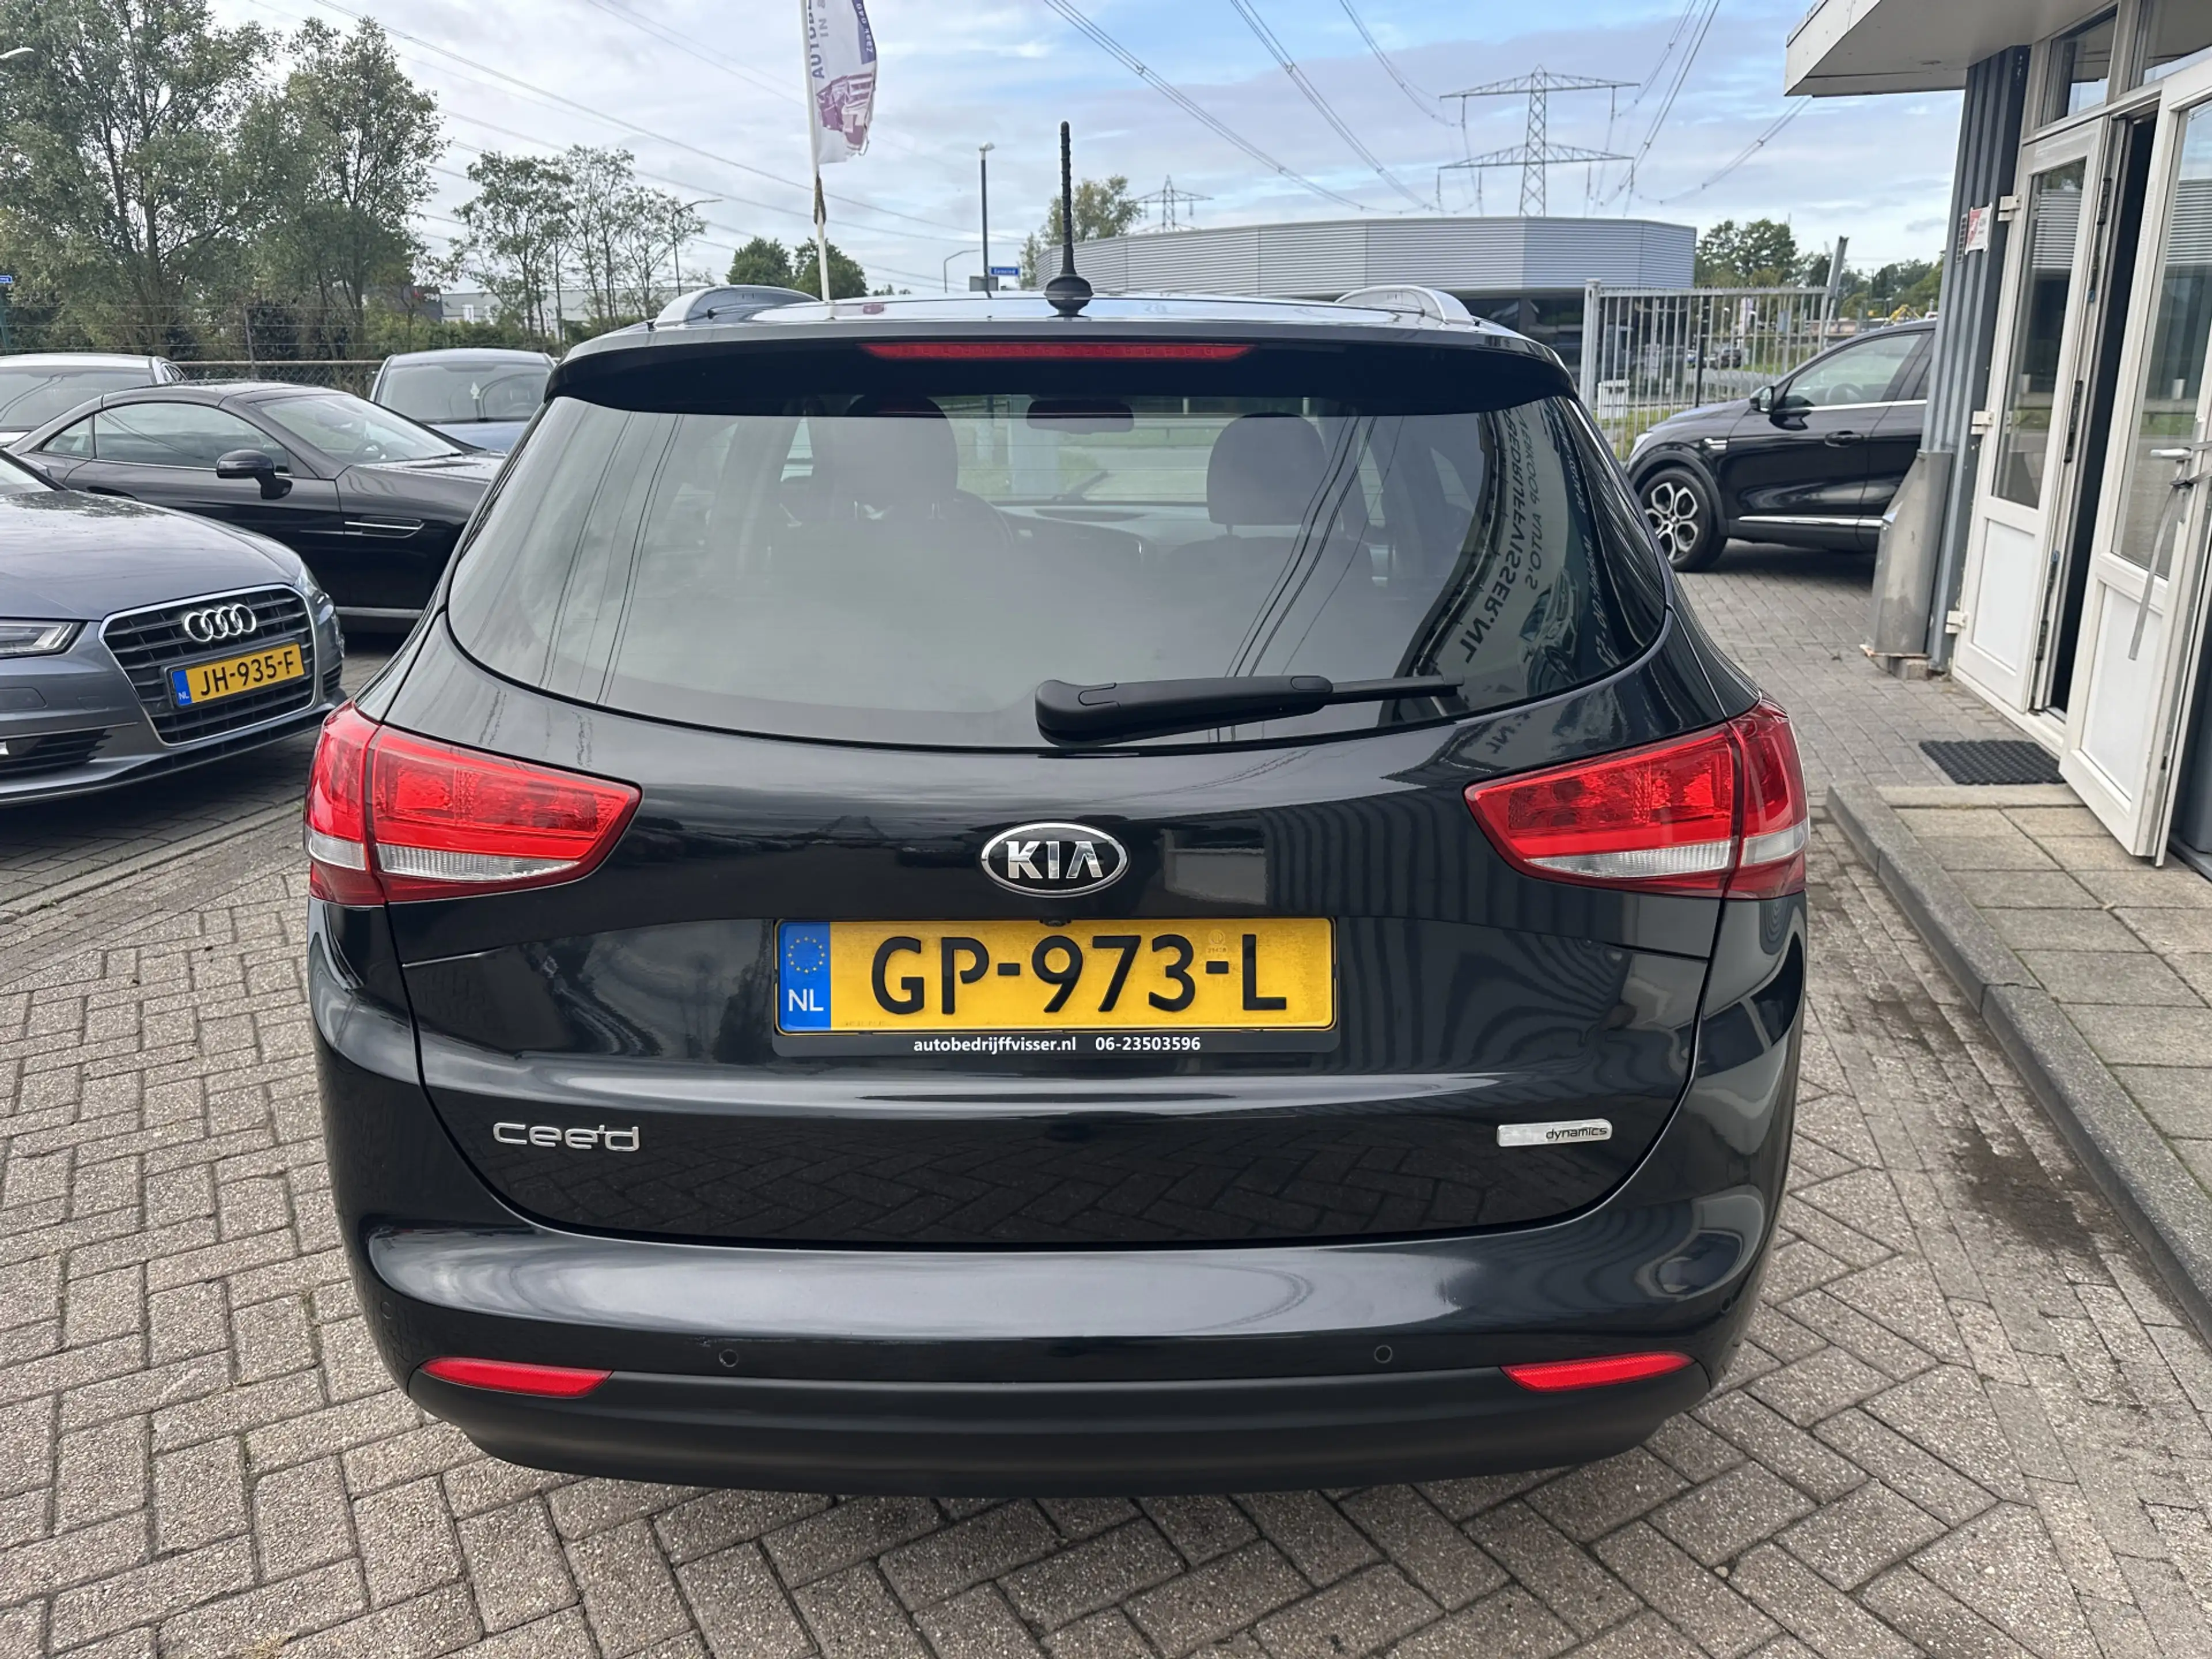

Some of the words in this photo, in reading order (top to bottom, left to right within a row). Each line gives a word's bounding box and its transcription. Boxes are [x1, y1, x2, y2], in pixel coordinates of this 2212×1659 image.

[818, 18, 829, 37] IN
[200, 650, 294, 696] JH-935-F
[178, 692, 190, 700] NL
[1006, 840, 1103, 879] KIA
[871, 934, 1287, 1015] GP-973-L
[787, 988, 824, 1012] NL
[913, 1036, 1077, 1054] autobedrijffvisser.nl
[1095, 1036, 1201, 1052] 06-23503596
[1546, 1127, 1608, 1141] dynamics
